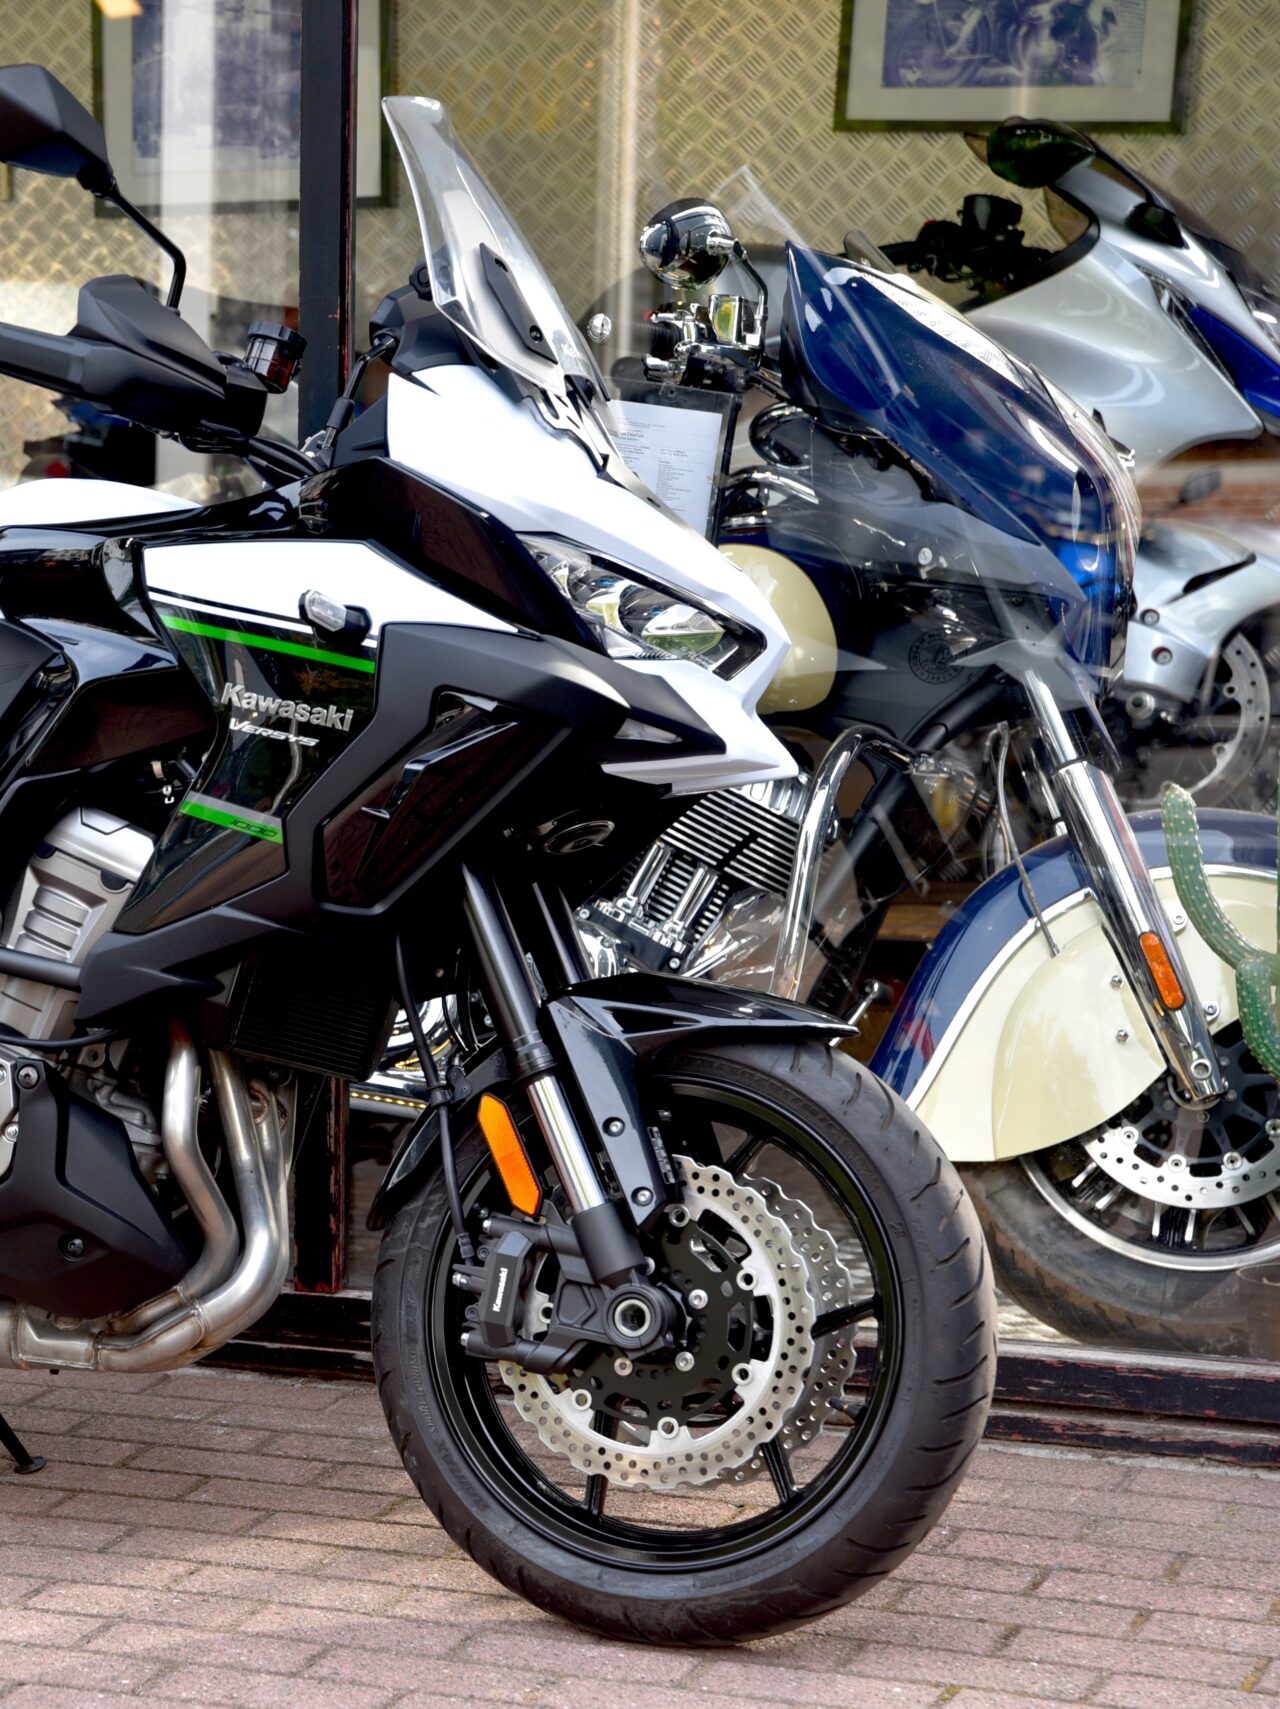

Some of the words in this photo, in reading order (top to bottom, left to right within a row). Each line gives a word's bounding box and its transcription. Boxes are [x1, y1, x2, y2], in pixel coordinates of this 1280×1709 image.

[221, 682, 354, 732] Kawasaki
[231, 818, 277, 840] 1000
[492, 1266, 509, 1313] Kawasaki
